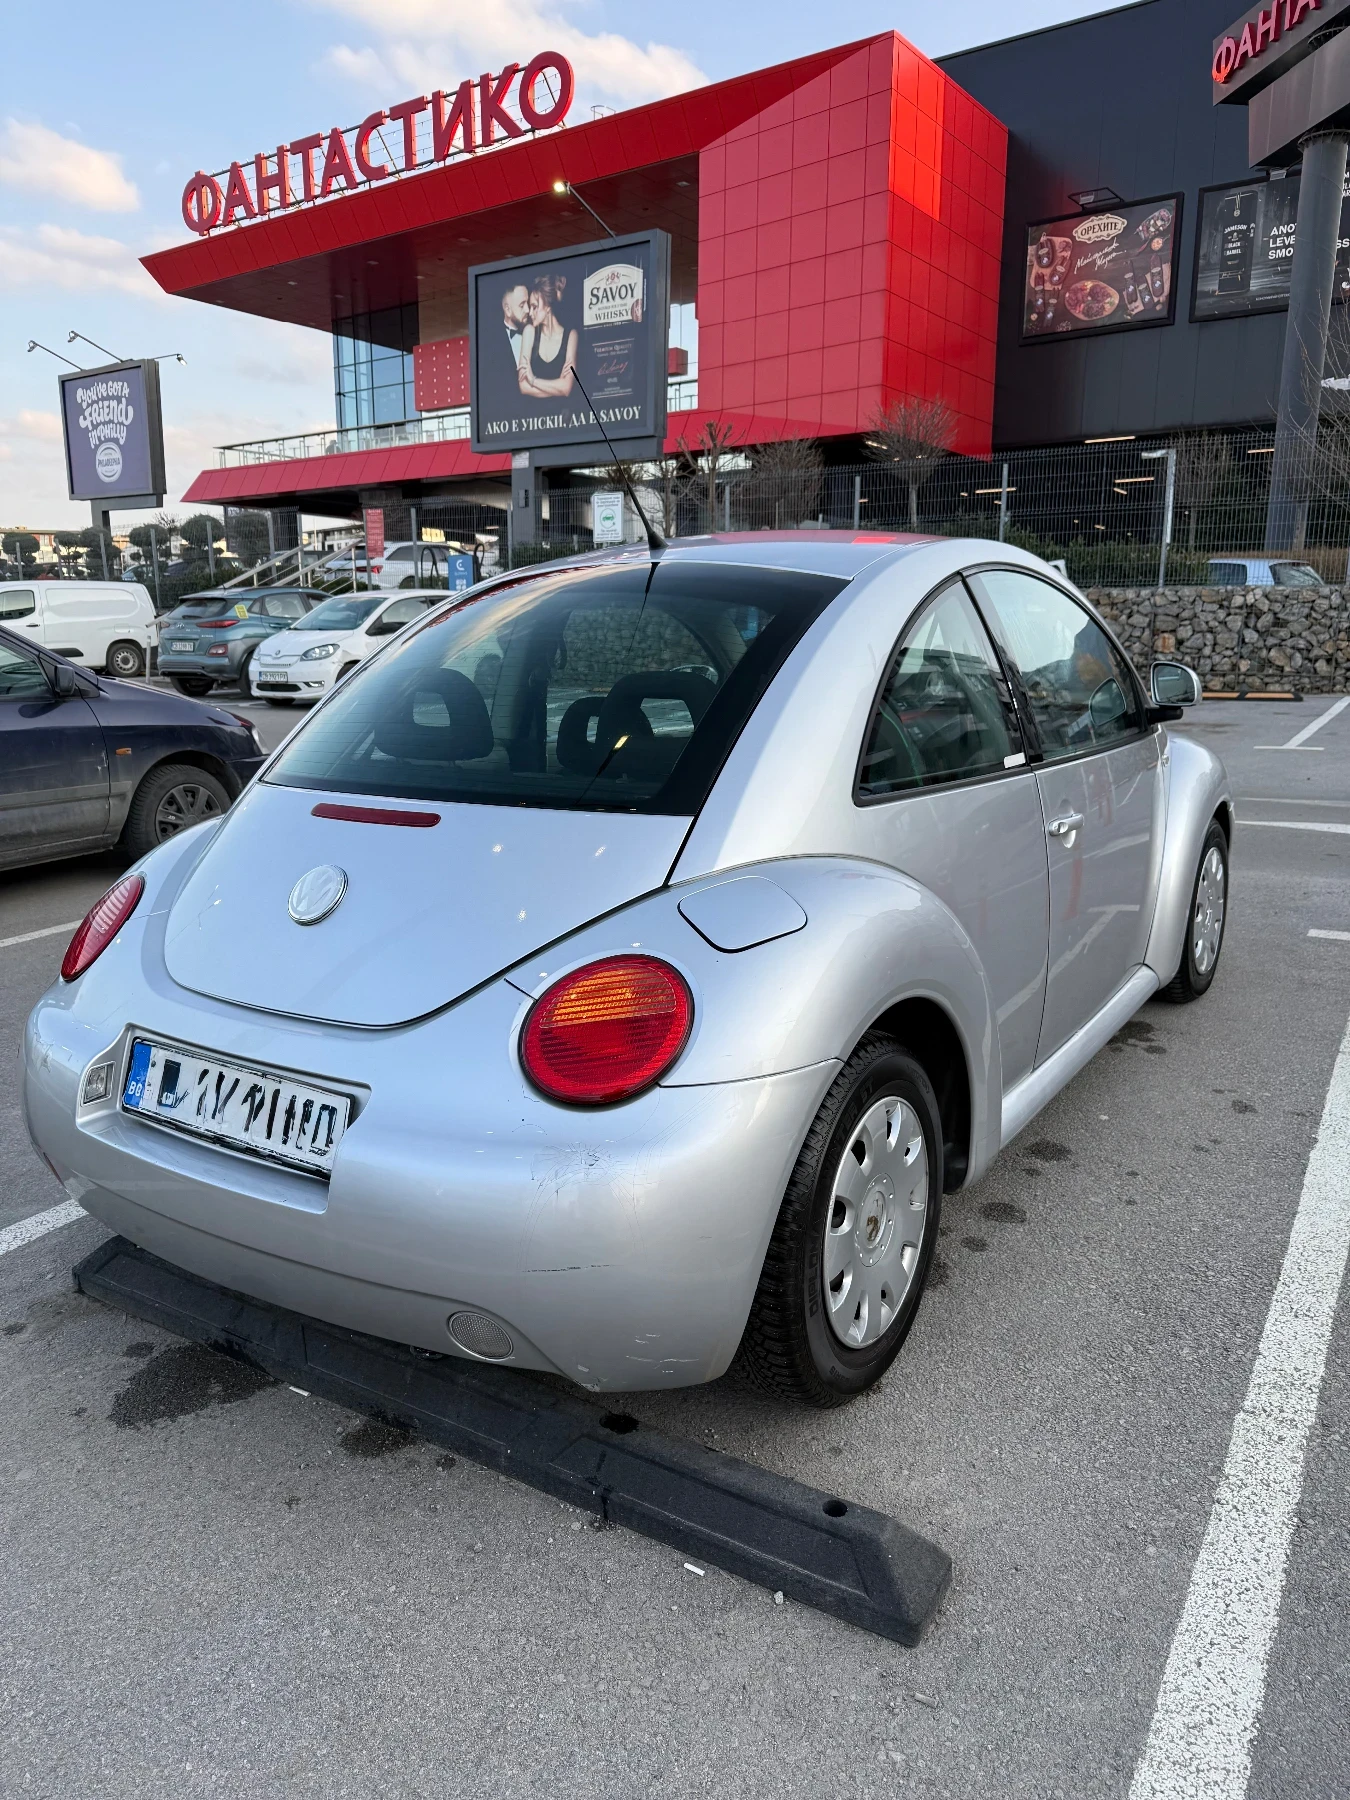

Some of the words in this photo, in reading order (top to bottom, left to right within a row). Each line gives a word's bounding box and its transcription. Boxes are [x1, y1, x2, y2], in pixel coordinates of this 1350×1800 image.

[182, 50, 575, 236] ФАНТАСТИКО
[1080, 221, 1119, 236] ОРЕХИТЕ
[1223, 224, 1248, 234] JAMESON
[588, 282, 637, 309] SAVOY
[595, 308, 631, 321] WHISKY
[485, 420, 509, 435] АКО
[512, 419, 519, 432] Е
[521, 414, 567, 431] УИСКИ,
[568, 412, 587, 428] ДА
[600, 405, 642, 423] SAVOY
[97, 457, 121, 469] PHILADELPHIA
